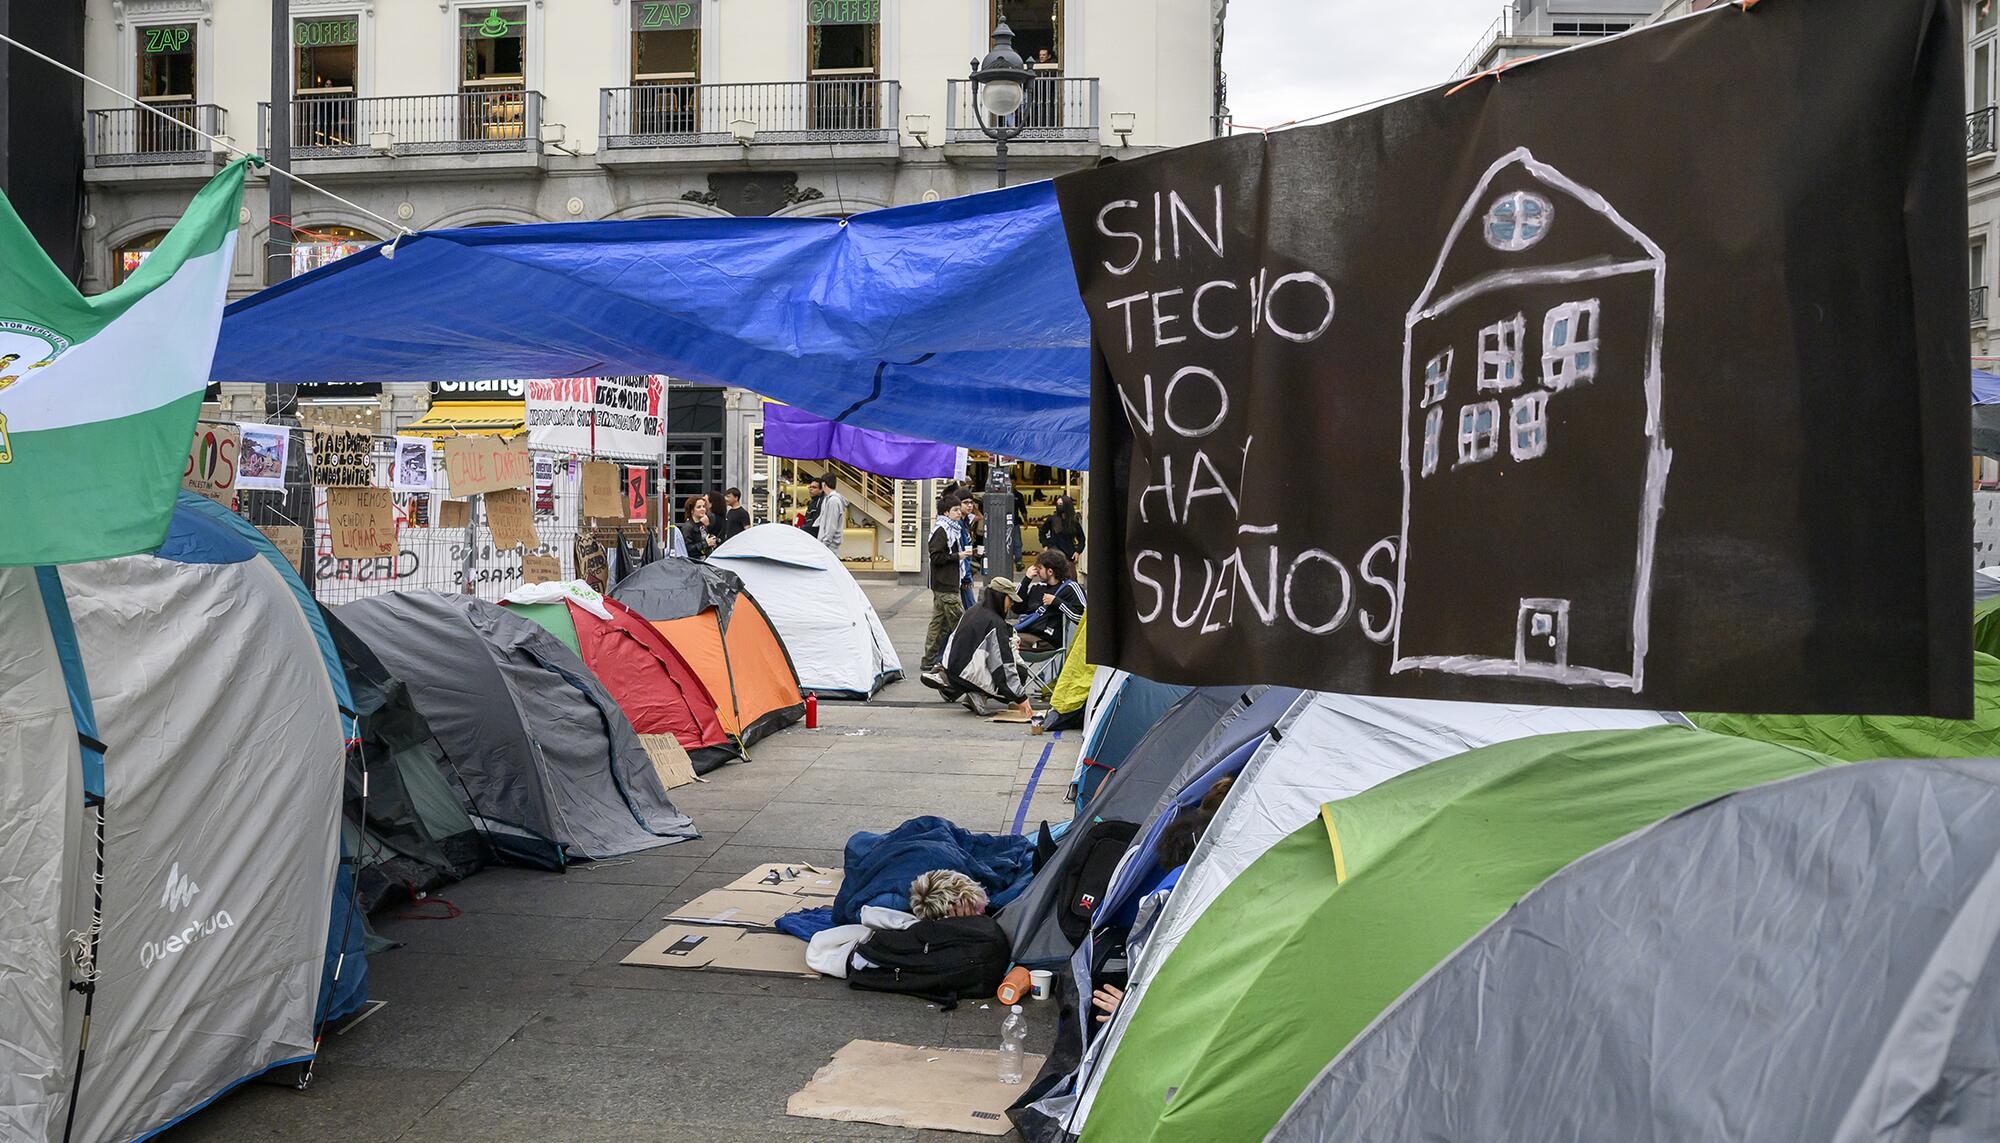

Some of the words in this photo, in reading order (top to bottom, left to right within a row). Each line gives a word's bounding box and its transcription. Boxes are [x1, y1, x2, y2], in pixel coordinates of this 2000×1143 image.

[641, 3, 691, 28] ZAP
[808, 0, 879, 23] COFFEE
[146, 27, 190, 53] ZAP
[294, 21, 358, 46] COFFEE
[1096, 184, 1224, 275] SIN
[1117, 365, 1229, 439] NO
[451, 451, 487, 487] CALLE
[357, 492, 388, 509] HEMOS
[369, 514, 376, 528] A
[341, 527, 378, 551] LUCHAR
[1133, 523, 1398, 645] SUEÑOS
[140, 910, 234, 969] Quechua
